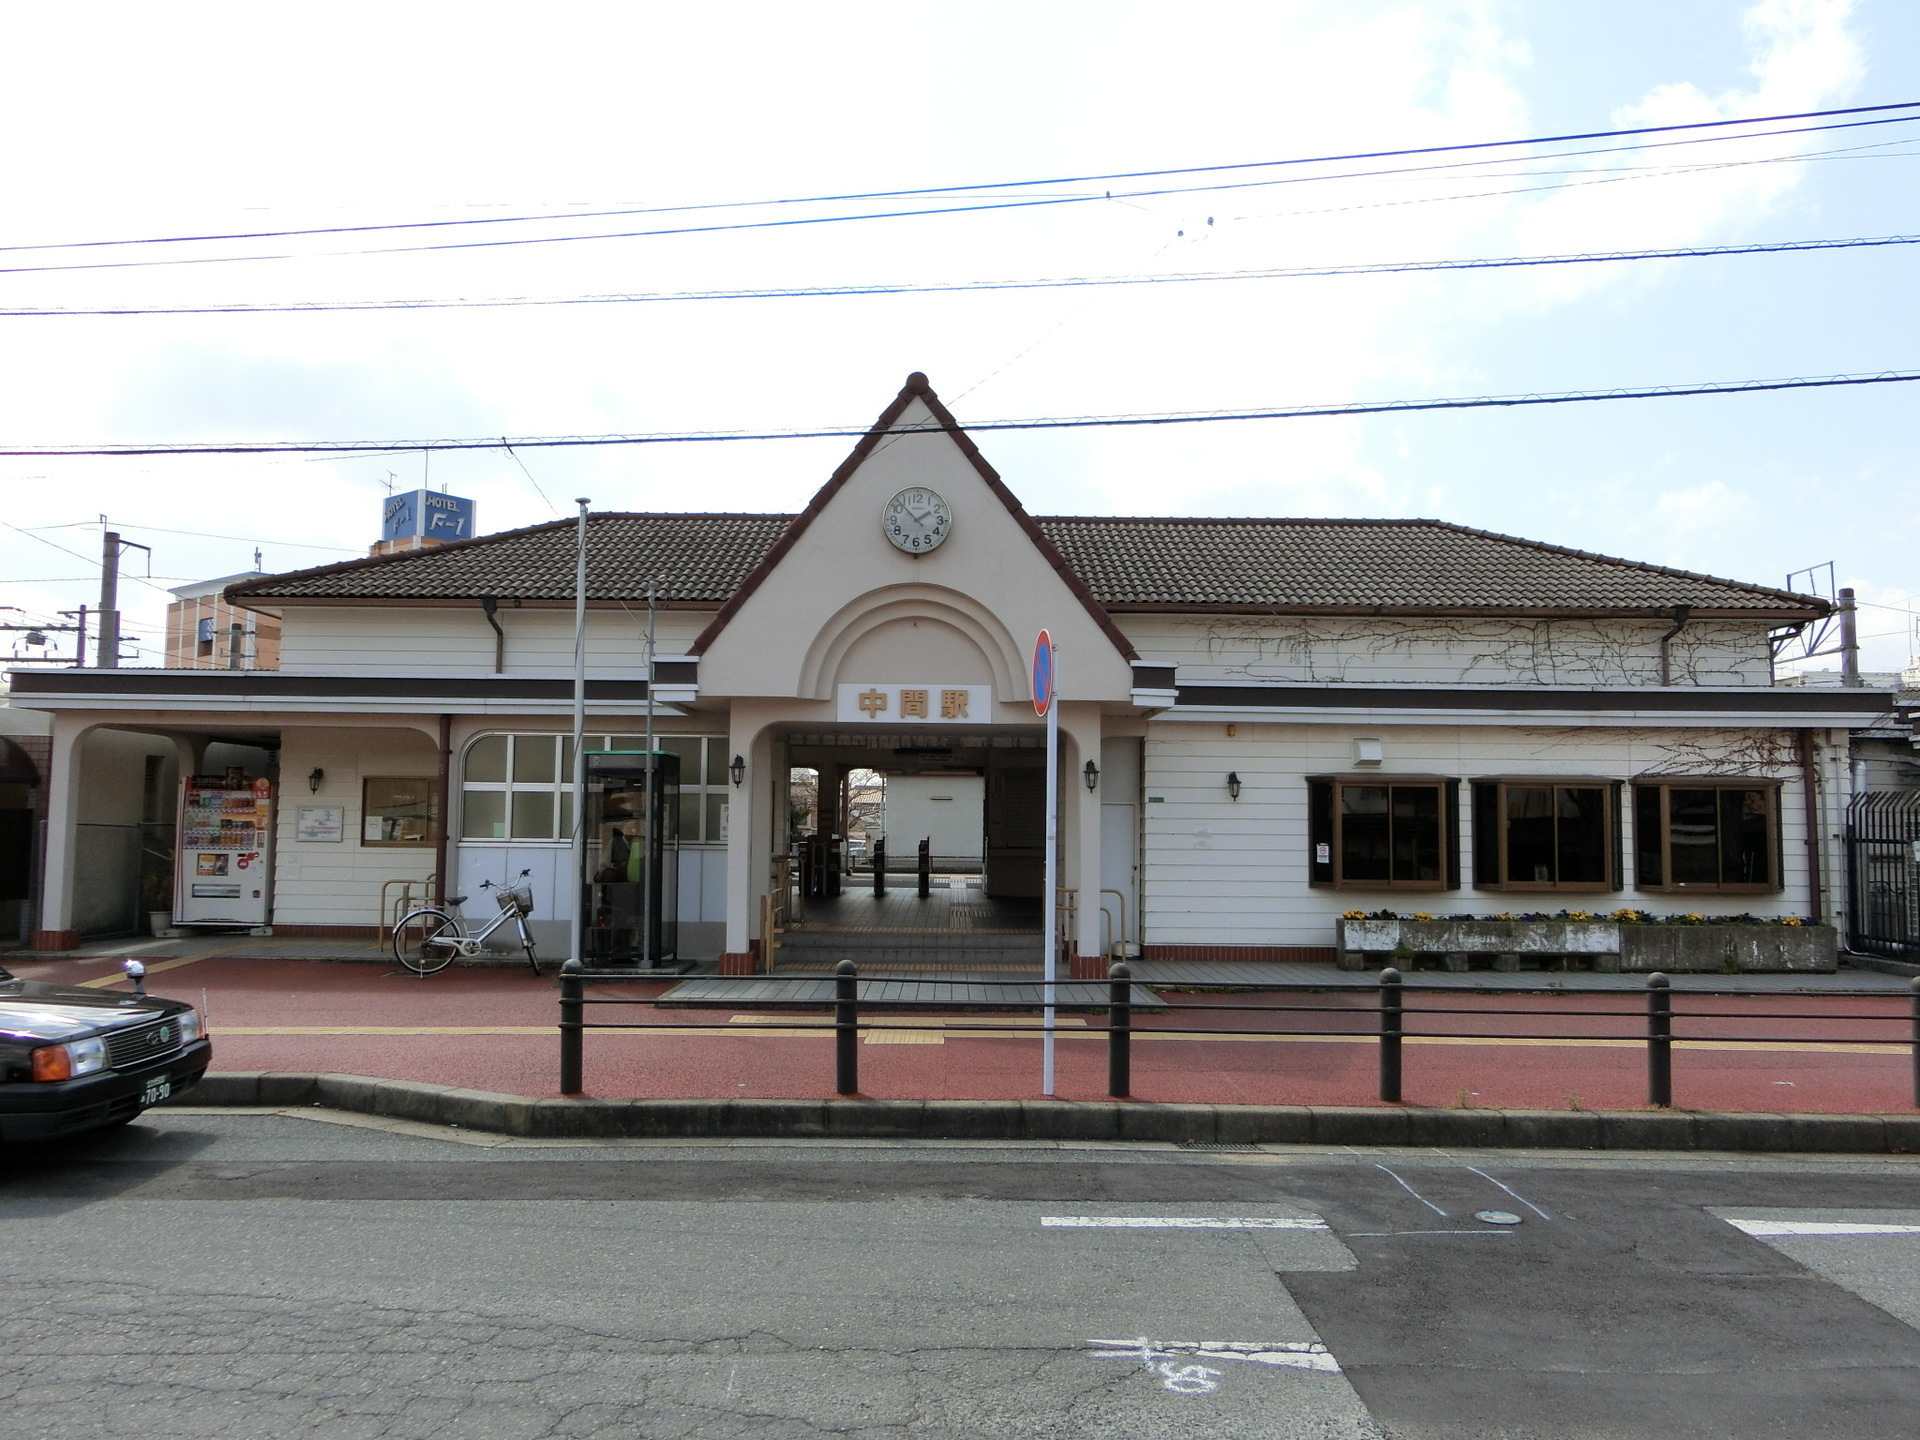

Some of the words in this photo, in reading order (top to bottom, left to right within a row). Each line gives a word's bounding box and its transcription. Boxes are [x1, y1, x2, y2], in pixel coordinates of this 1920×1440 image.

[425, 495, 460, 513] HOTEL
[913, 493, 924, 504] 12
[384, 498, 406, 524] HOTEL
[890, 503, 904, 515] 10
[933, 503, 941, 514] 2
[429, 512, 466, 536] F-1
[890, 515, 898, 525] 9
[936, 515, 944, 525] 3
[893, 525, 901, 536] 8
[932, 526, 940, 536] 4
[902, 534, 909, 544] 7
[912, 537, 920, 548] 6
[924, 534, 932, 545] 5
[859, 688, 969, 719] 中間駅
[145, 1082, 170, 1105] 70-90
